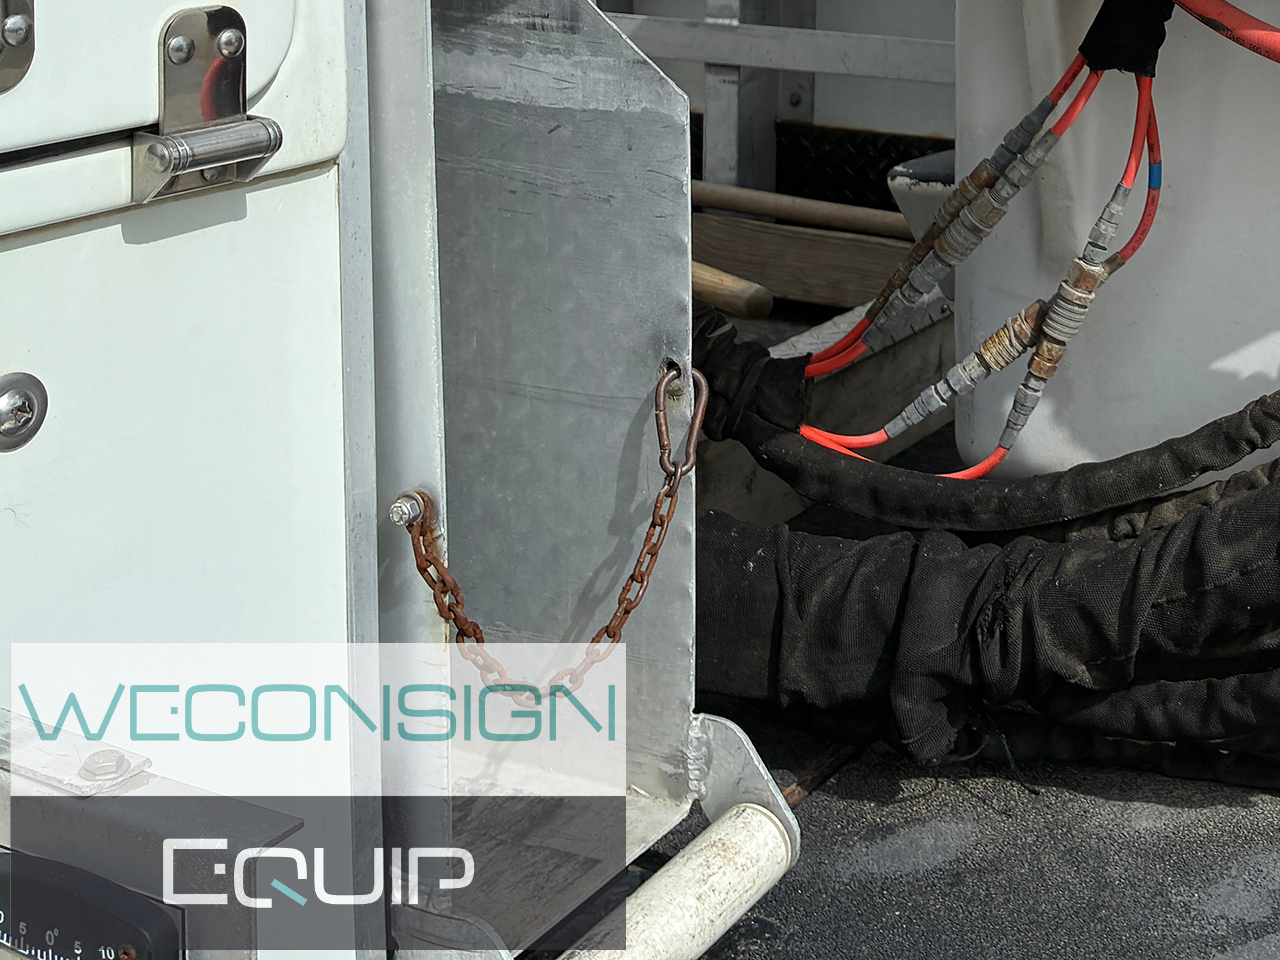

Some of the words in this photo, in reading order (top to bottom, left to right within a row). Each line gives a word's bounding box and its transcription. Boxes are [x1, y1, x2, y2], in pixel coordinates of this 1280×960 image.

[19, 921, 27, 935] 5
[74, 941, 83, 954] 5
[99, 945, 115, 960] 10
